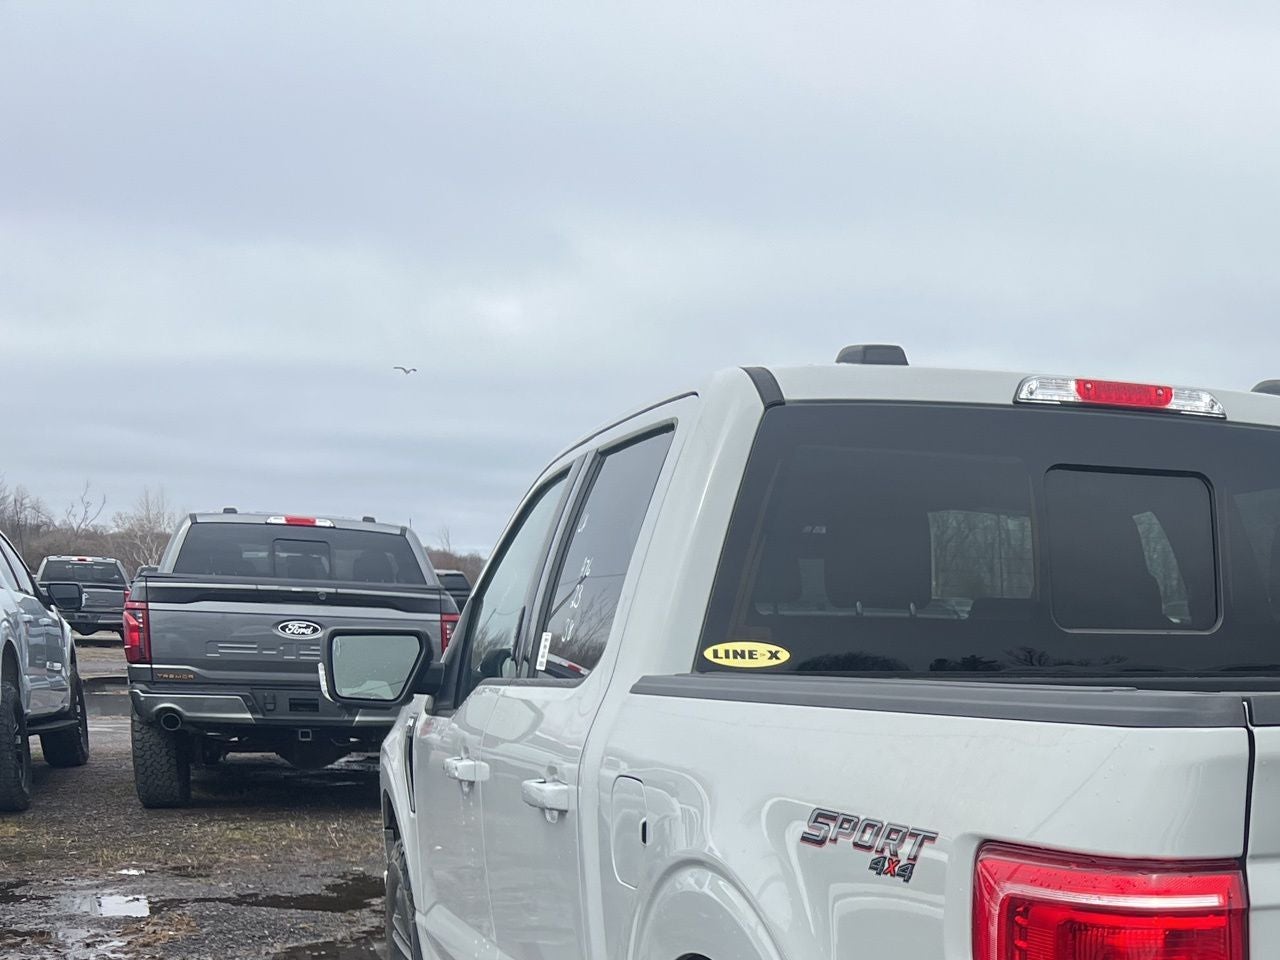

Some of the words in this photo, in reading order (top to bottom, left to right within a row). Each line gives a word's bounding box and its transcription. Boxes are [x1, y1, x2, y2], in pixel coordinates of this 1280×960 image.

[285, 623, 314, 635] Ford
[712, 648, 782, 660] LINE-X
[800, 807, 939, 863] SPORT
